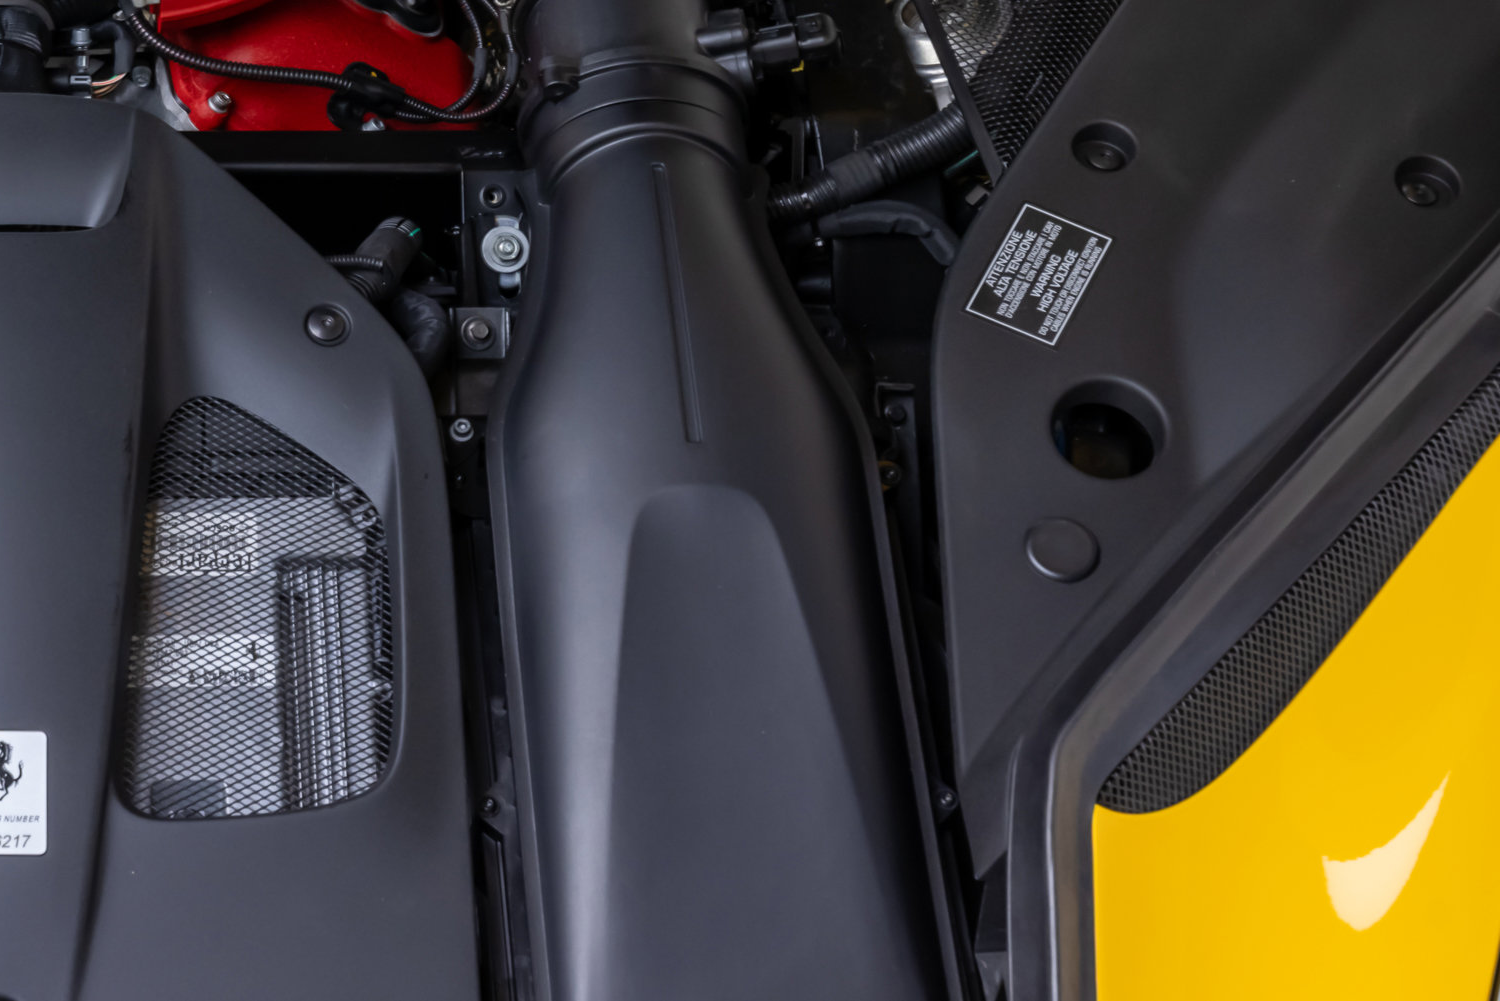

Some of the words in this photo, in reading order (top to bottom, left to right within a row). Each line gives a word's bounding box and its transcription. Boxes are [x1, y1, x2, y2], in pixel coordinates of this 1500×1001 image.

[983, 230, 1023, 287] ATTENZIONE
[992, 274, 1012, 297] ALTA
[1004, 229, 1038, 275] TENSIONE
[1029, 253, 1062, 298] WARNING
[1035, 287, 1057, 312] HIGH
[1049, 248, 1079, 289] VOLTAGE
[4, 814, 40, 823] NUMBER
